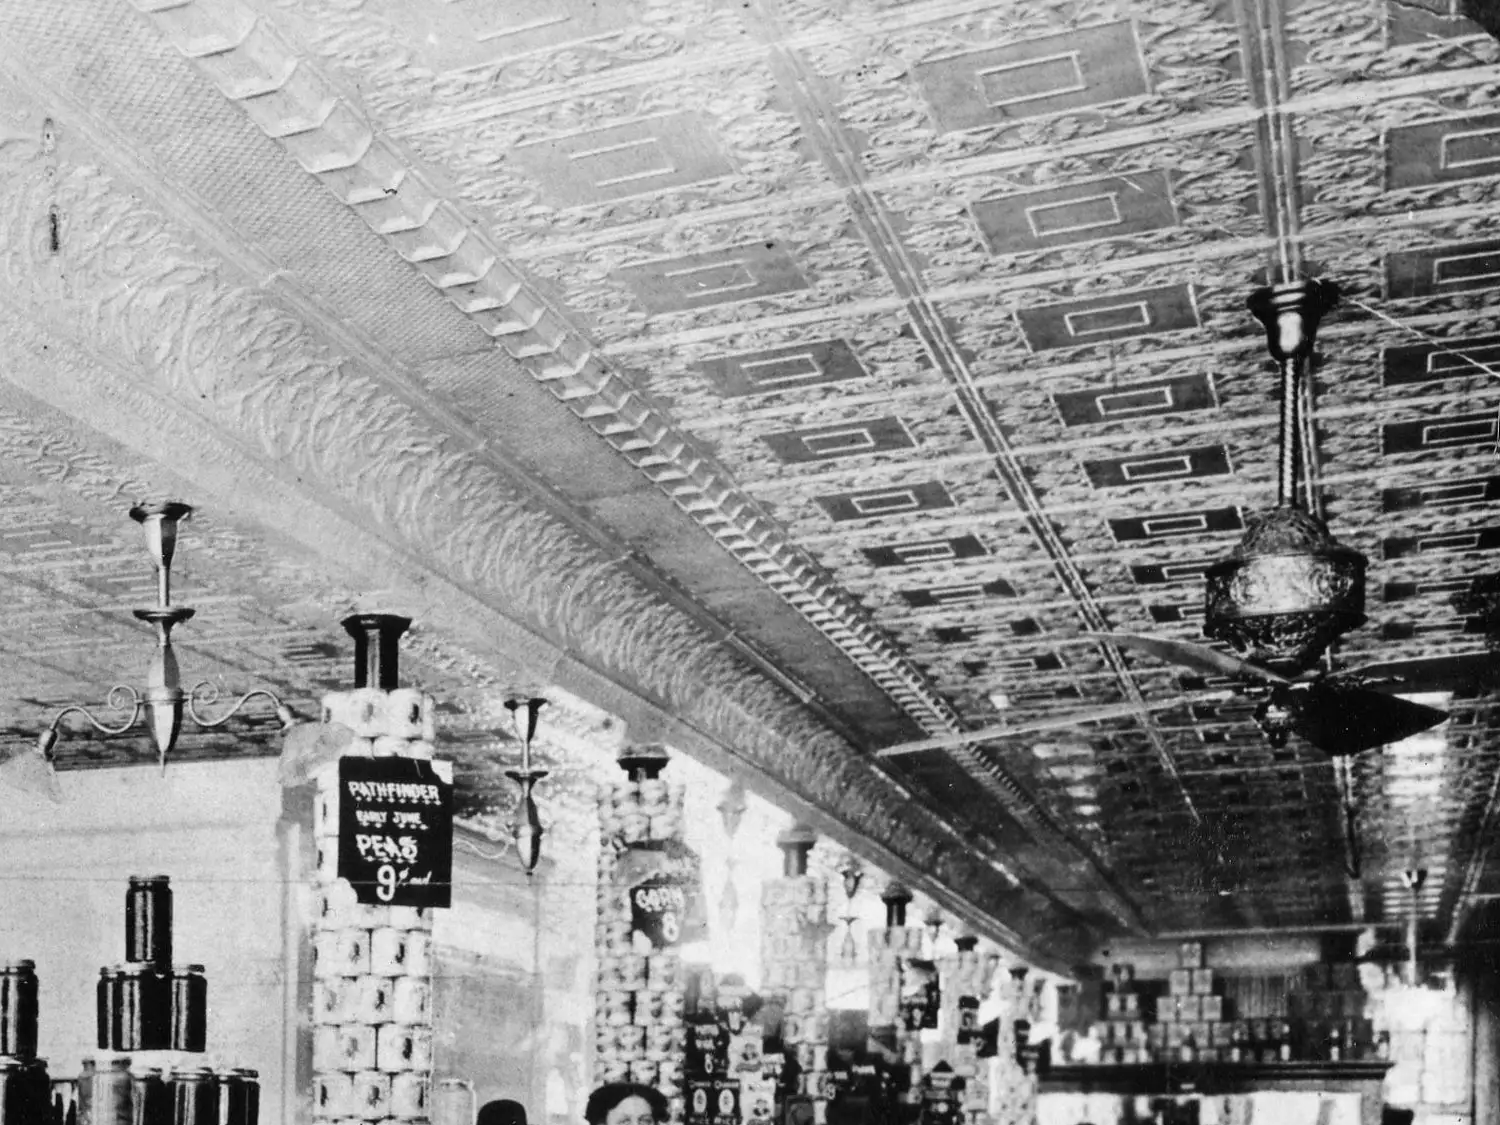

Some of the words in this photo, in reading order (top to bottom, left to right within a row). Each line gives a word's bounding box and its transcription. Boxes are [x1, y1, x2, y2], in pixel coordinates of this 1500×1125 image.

[348, 781, 440, 800] PATHFINDER
[392, 811, 423, 825] JUNE
[355, 833, 419, 860] PEAS
